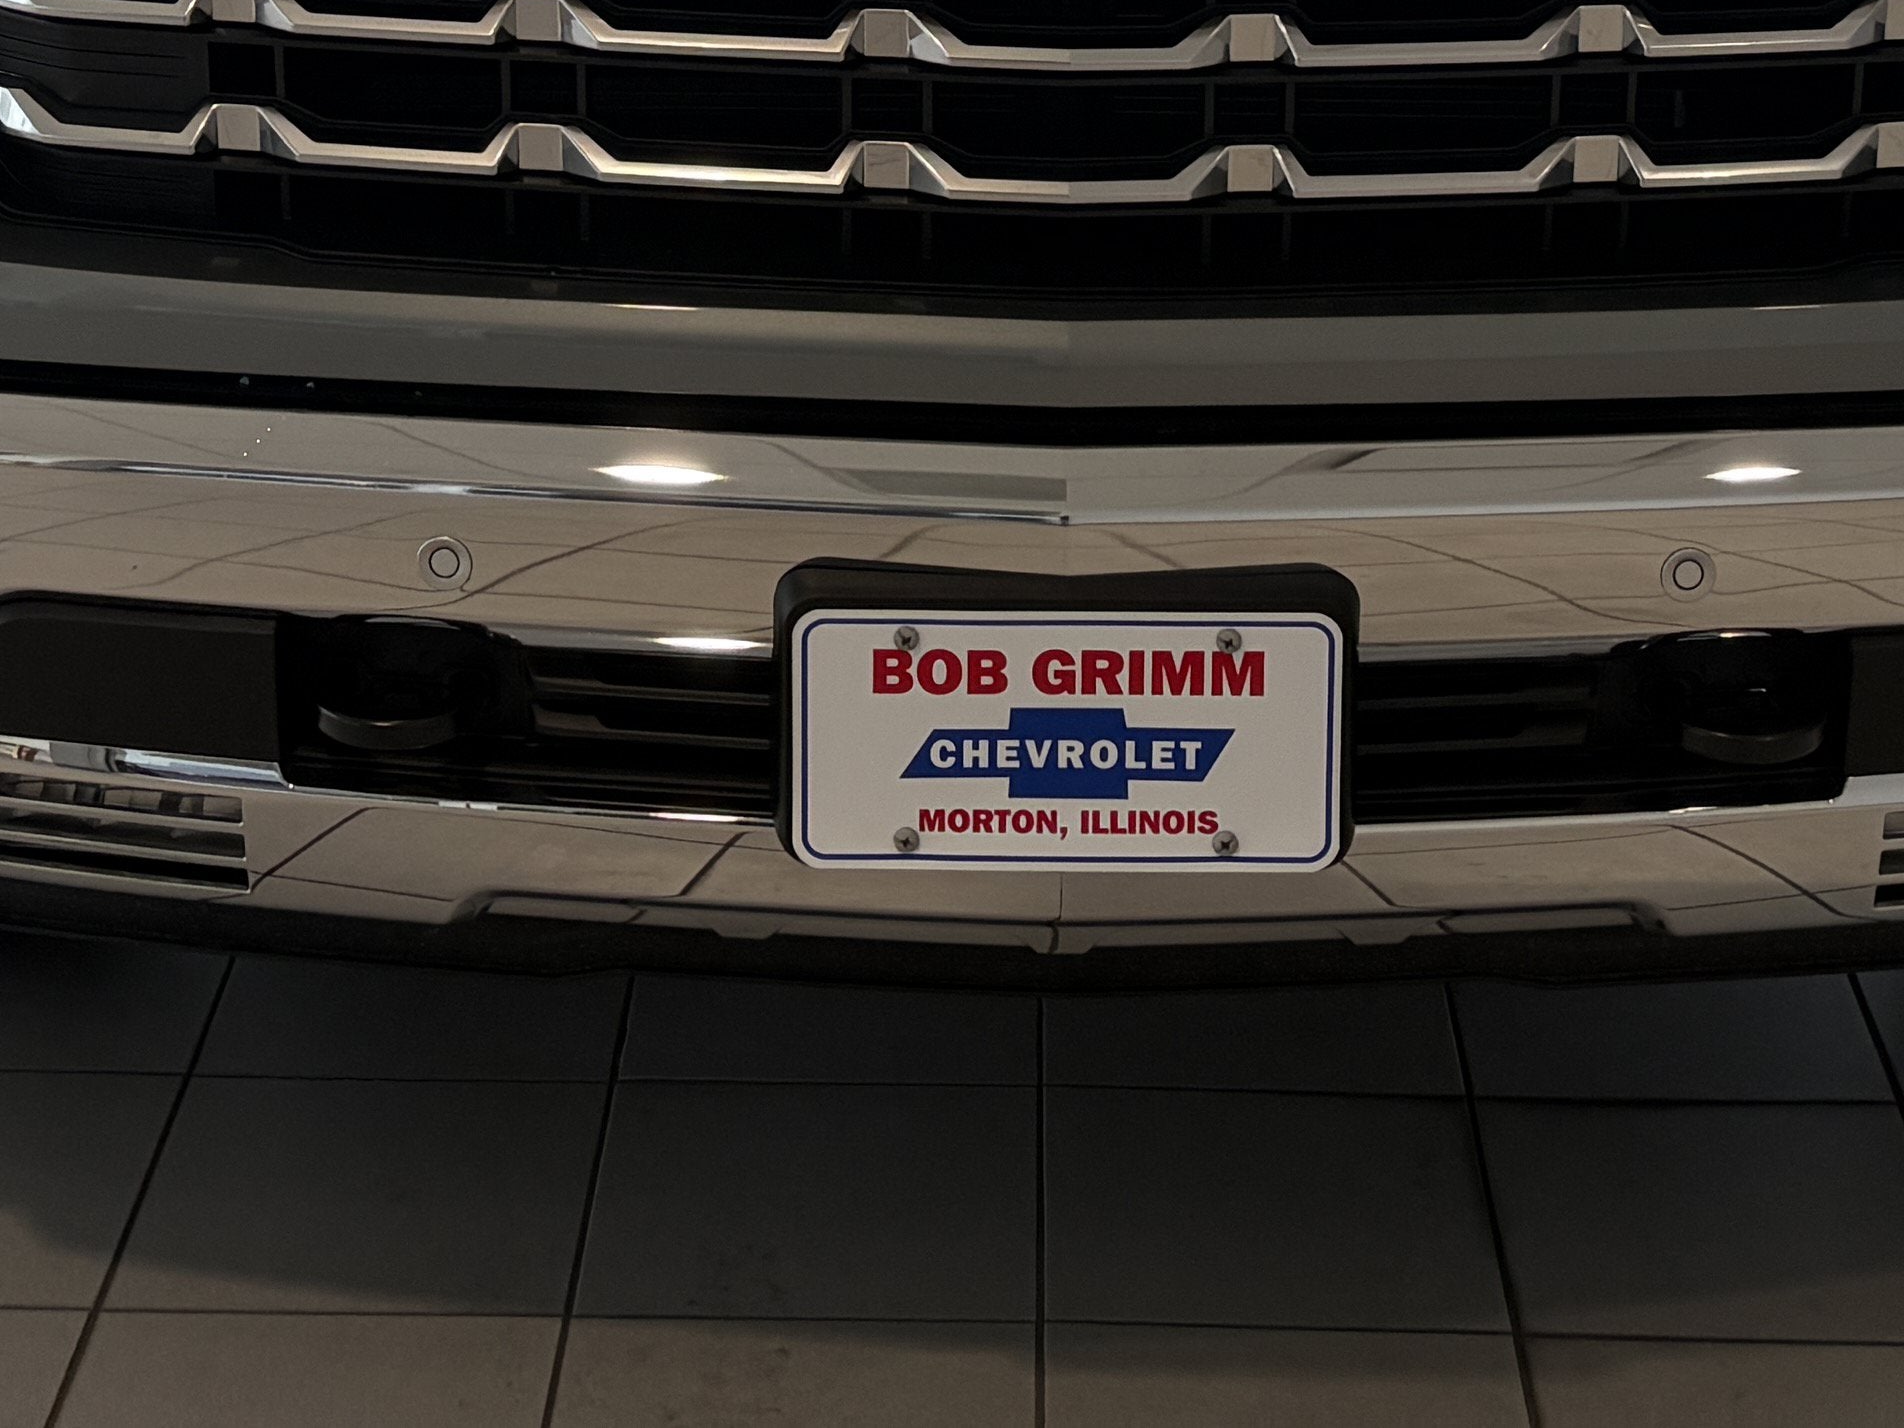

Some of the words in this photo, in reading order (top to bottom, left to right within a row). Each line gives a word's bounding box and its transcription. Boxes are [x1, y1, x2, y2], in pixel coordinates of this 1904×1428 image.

[872, 648, 1008, 695] BOB
[1031, 649, 1265, 697] GRIMM
[929, 738, 1203, 771] CHEVROLET
[918, 808, 1070, 840] MORTON,
[1079, 810, 1220, 835] ILLINOIS
